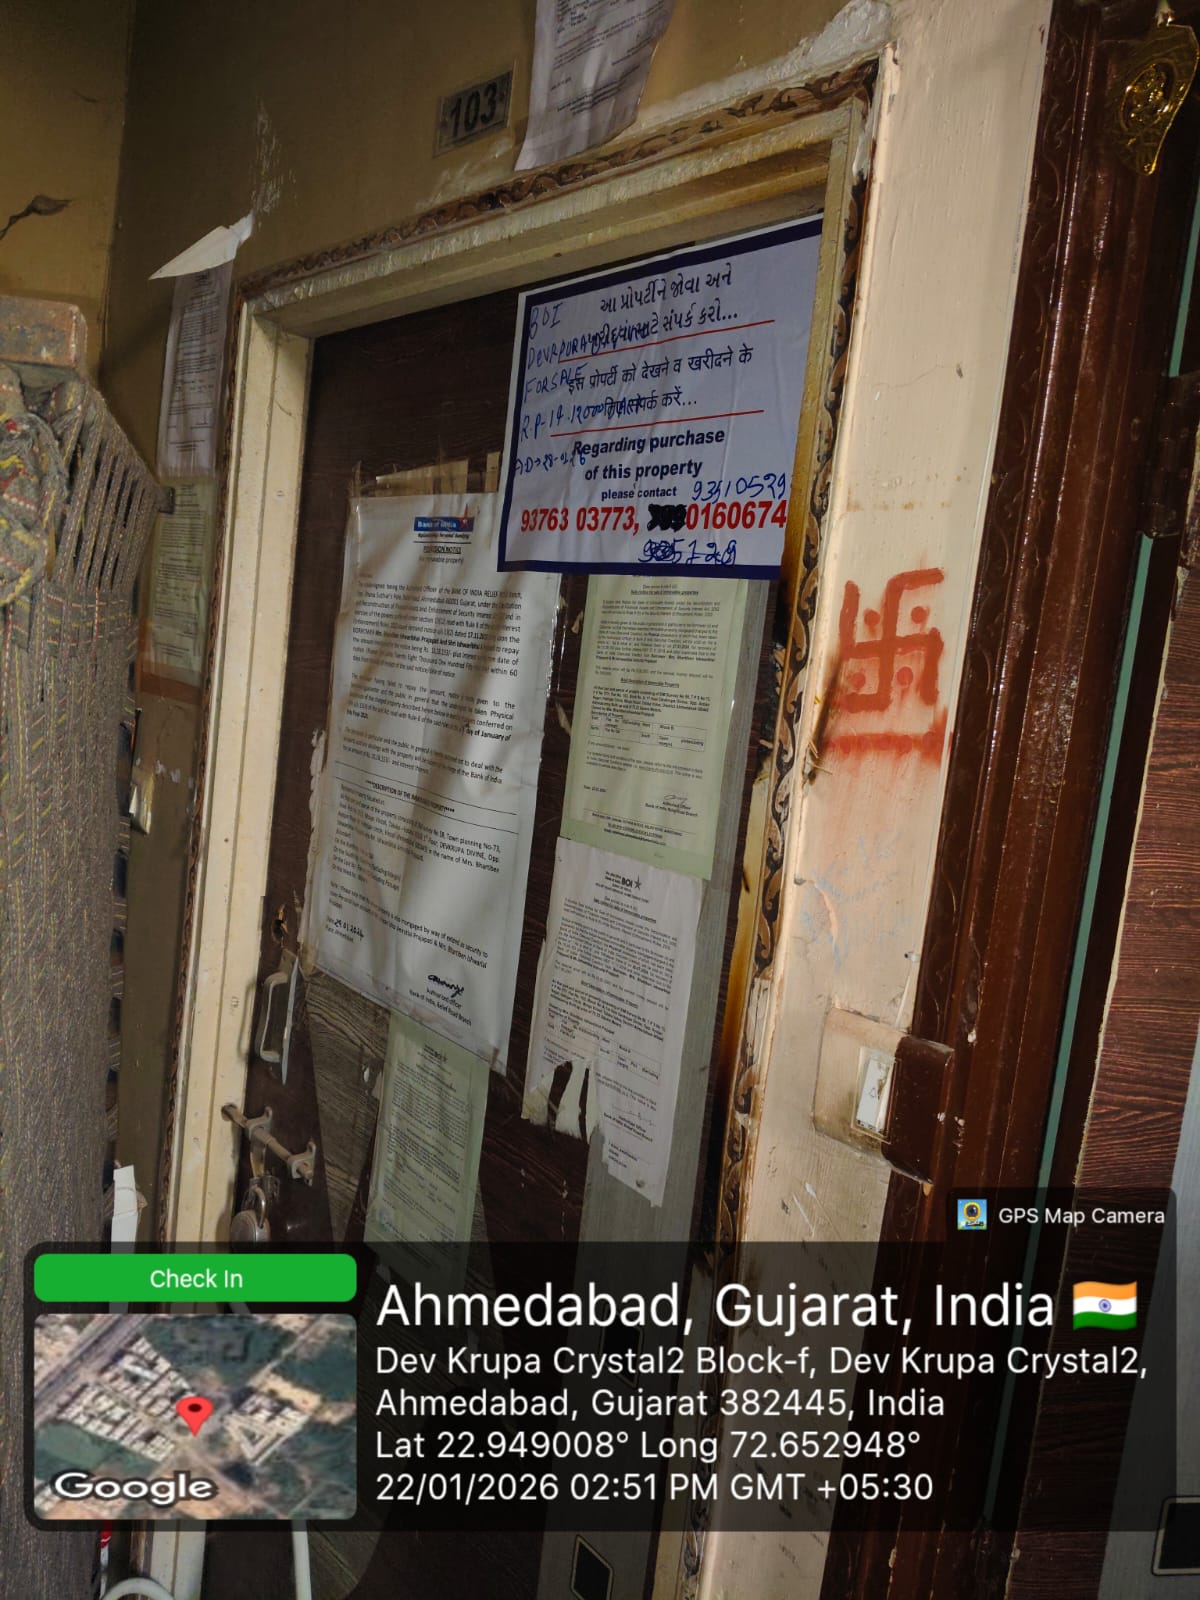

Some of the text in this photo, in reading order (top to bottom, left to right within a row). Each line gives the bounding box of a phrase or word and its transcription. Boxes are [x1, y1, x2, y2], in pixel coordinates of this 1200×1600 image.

[450, 81, 500, 137] 103
[600, 298, 617, 313] આ
[705, 262, 733, 288] અને
[622, 363, 637, 383] को
[641, 356, 670, 378] देखने
[673, 358, 683, 373] व
[688, 346, 734, 371] खरीदने
[739, 342, 754, 365] के
[573, 429, 726, 459] Regarding purchase
[585, 459, 704, 482] of this property
[601, 486, 678, 502] please contact
[521, 507, 569, 532] 93763
[576, 505, 640, 536] 03773,
